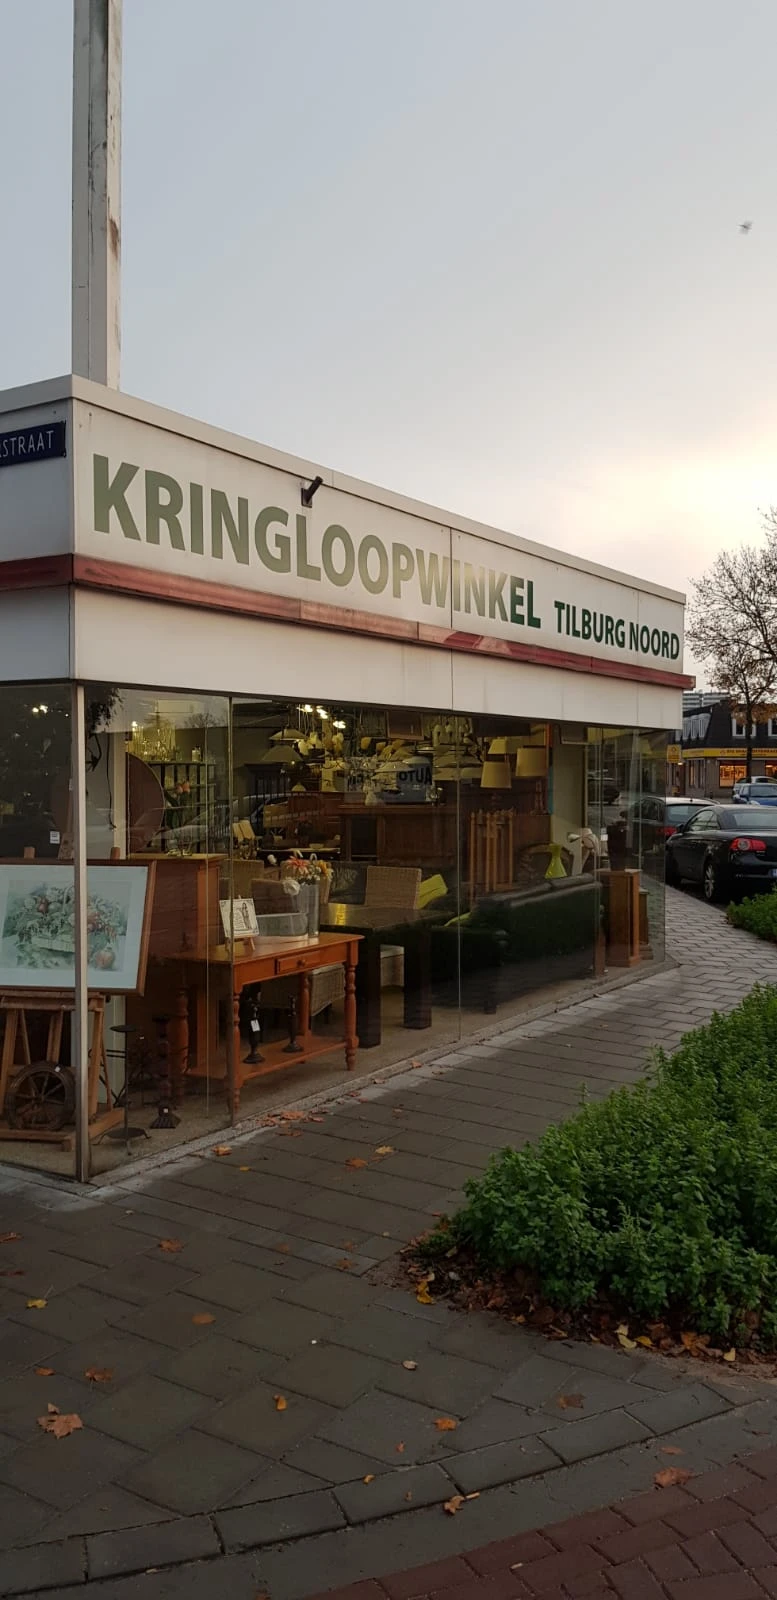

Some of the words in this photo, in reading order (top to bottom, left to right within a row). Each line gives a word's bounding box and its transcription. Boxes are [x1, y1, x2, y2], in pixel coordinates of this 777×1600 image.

[0, 430, 54, 458] STRAAT
[93, 453, 541, 629] KRINGLOOPWINKEL
[554, 600, 625, 648] TILBURG
[629, 621, 680, 660] NOORD
